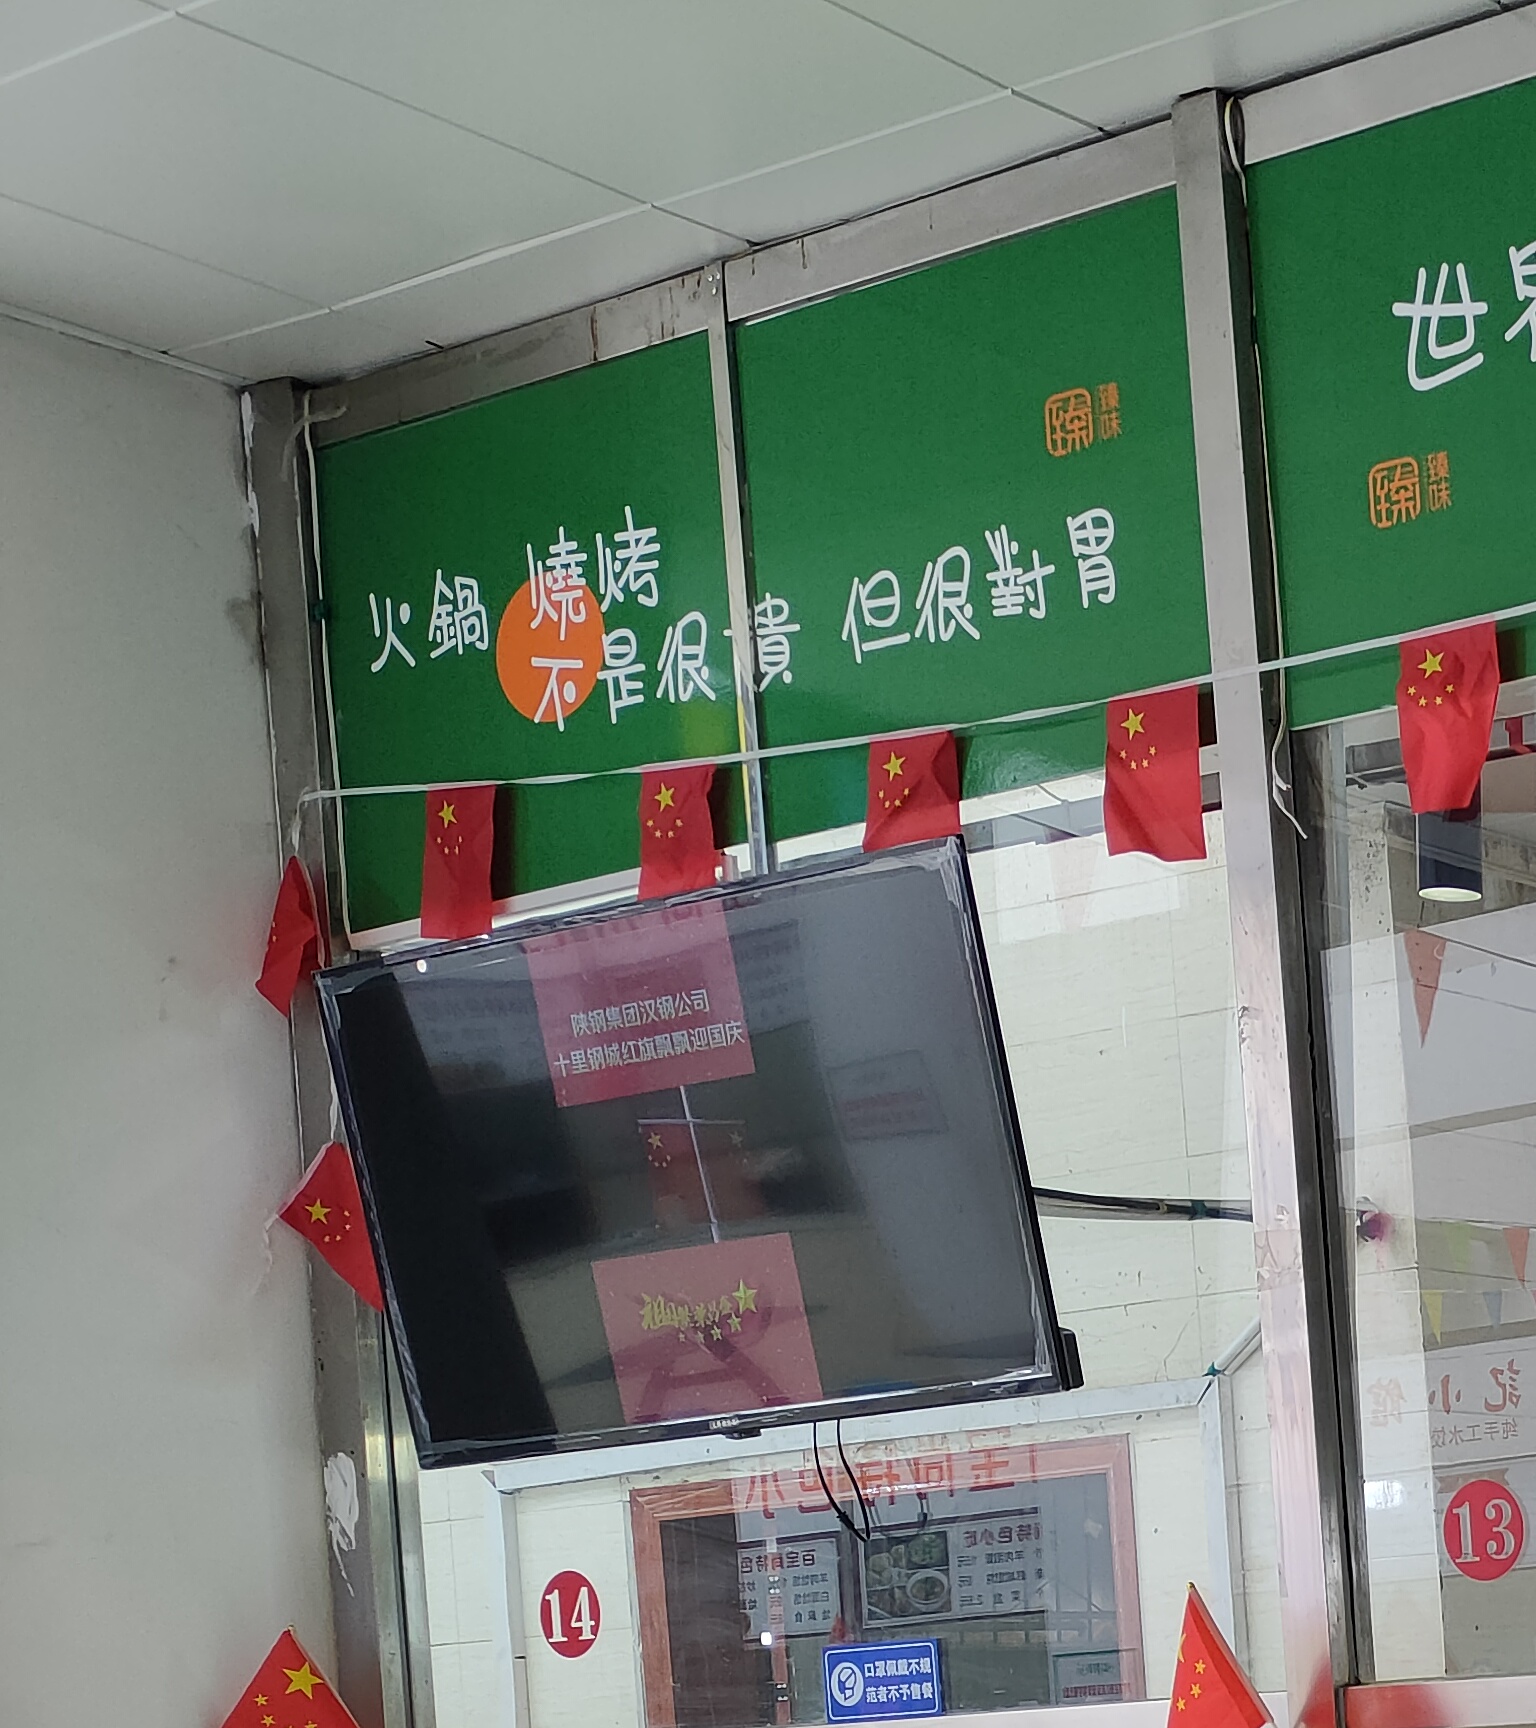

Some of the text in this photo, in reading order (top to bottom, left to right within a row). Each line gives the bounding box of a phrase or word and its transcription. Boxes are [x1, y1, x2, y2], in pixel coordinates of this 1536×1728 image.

[367, 505, 662, 675] 火鍋 燒烤
[530, 507, 1117, 732] 不是很貴 但很對胃
[570, 988, 711, 1038] 陕钢集团汉钢公司
[554, 1020, 746, 1079] 十里钢城红旗飘飘迎国庆
[1450, 1496, 1516, 1565] 13
[545, 1585, 597, 1645] 14
